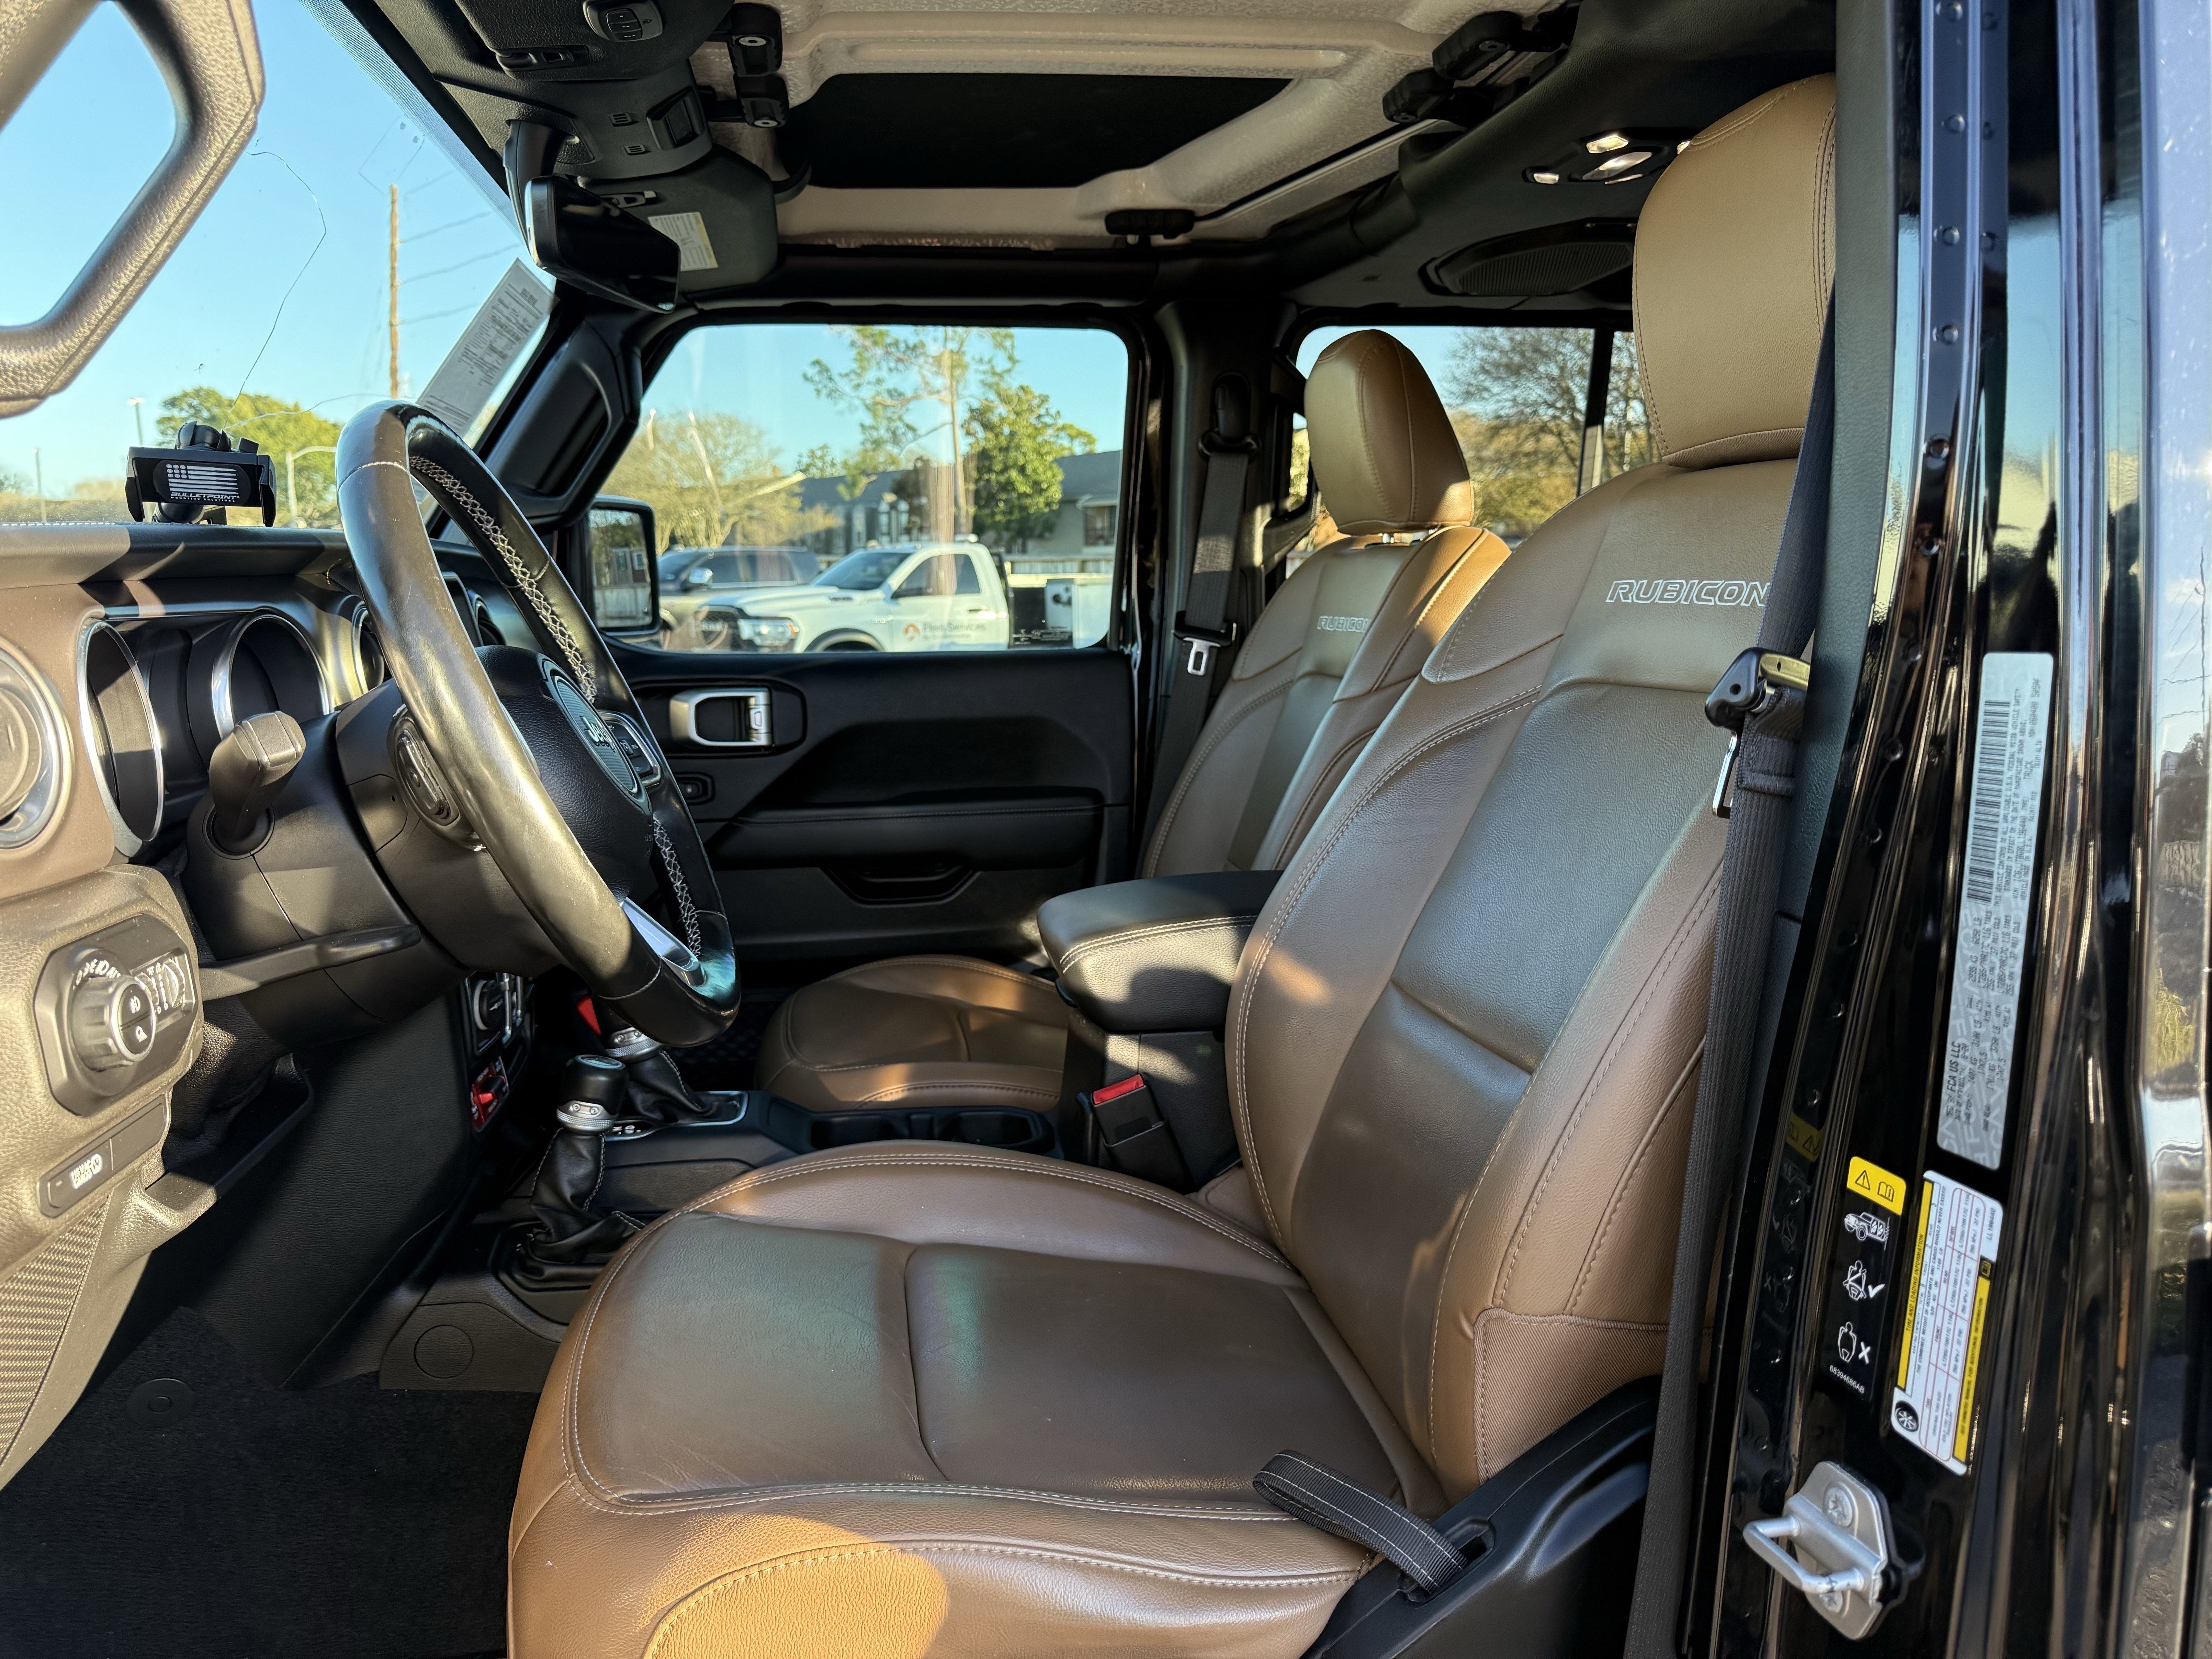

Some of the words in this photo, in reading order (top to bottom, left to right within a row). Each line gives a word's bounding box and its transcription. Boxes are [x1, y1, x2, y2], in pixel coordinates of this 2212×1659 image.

[1605, 579, 1772, 607] RUBICON
[579, 715, 616, 753] Jeep
[2022, 759, 2035, 781] TRUCK
[2006, 835, 2016, 854] EFFECT
[1996, 845, 2006, 870] CONFORMS
[1994, 871, 2004, 893] VEHICLE
[1993, 894, 2001, 907] THIS
[1971, 928, 1981, 946] 6250
[1950, 1040, 1961, 1059] LLC
[1971, 1029, 1981, 1048] 3100
[1946, 1073, 1957, 1093] FCA
[1913, 1232, 1924, 1276] INFORMATION
[1910, 1274, 1918, 1304] LOADING
[1925, 1275, 1934, 1308] OCCUPANTS
